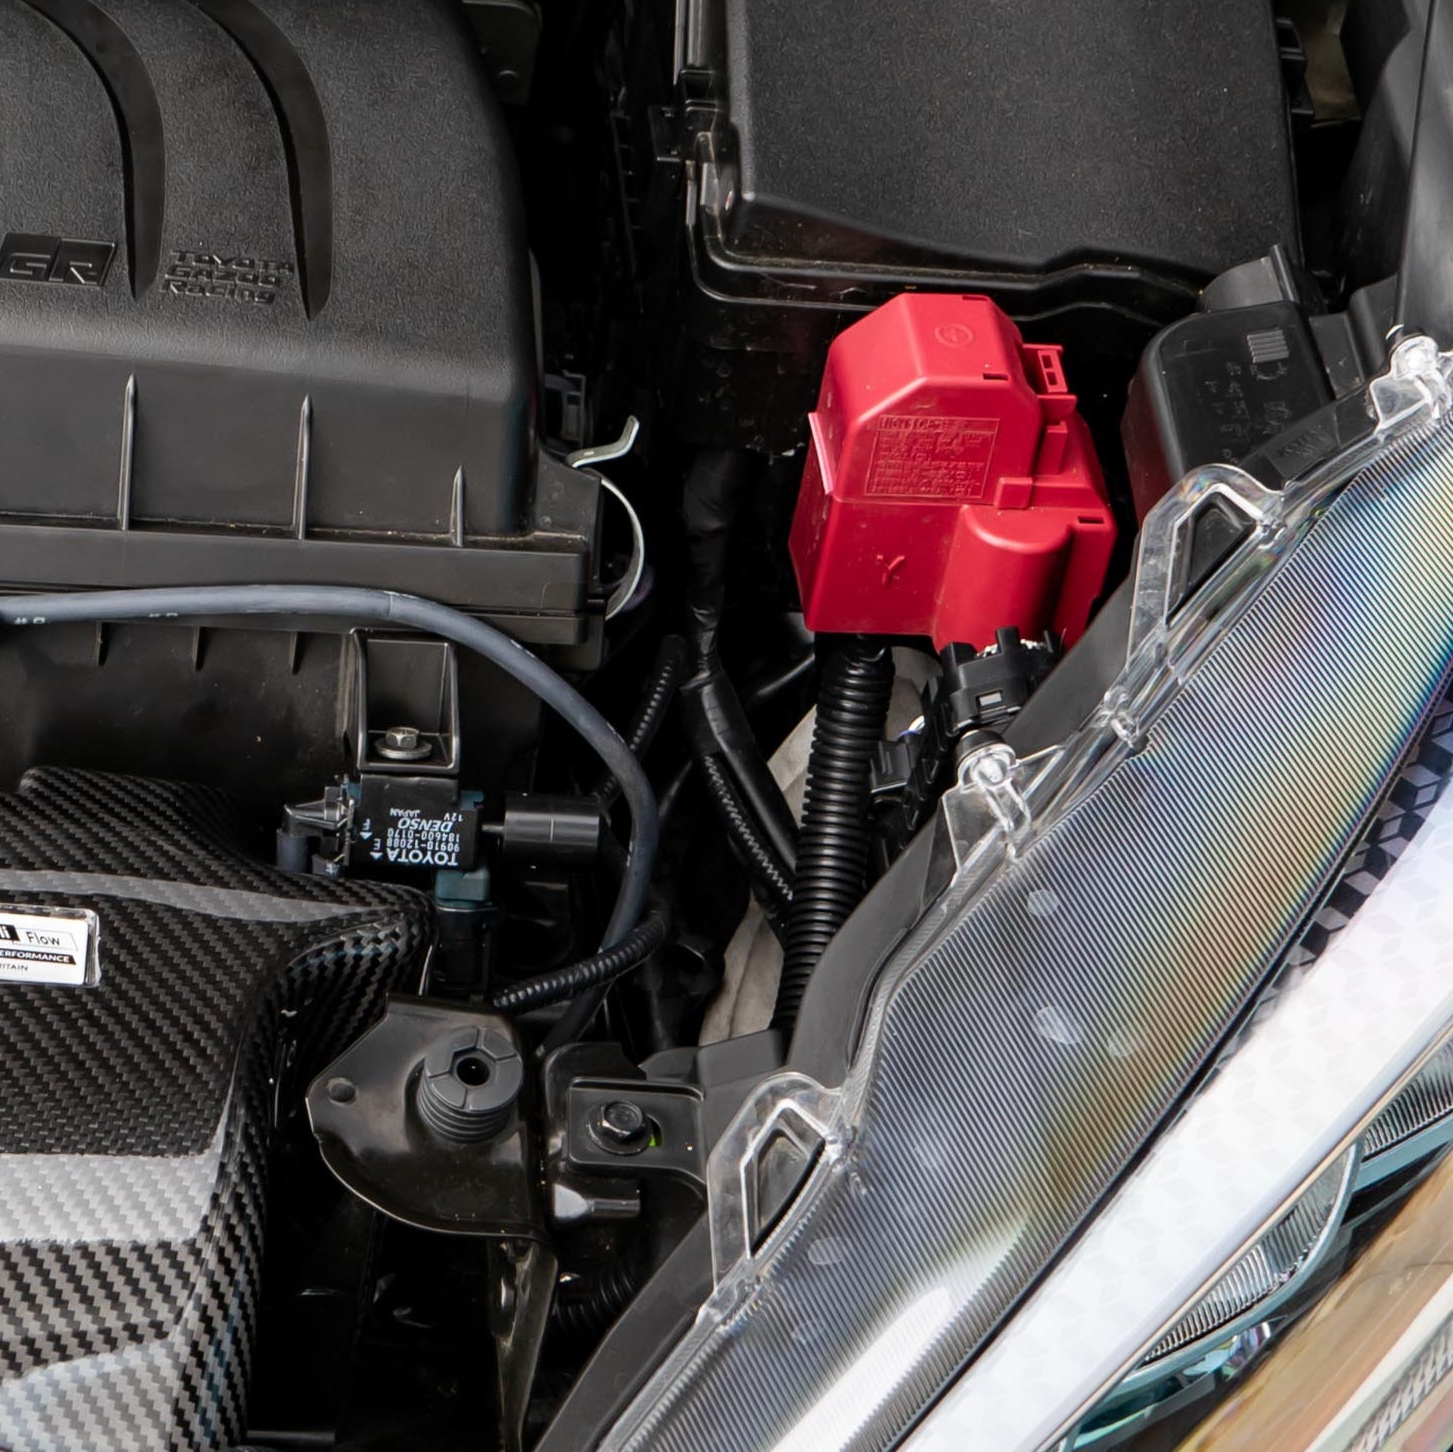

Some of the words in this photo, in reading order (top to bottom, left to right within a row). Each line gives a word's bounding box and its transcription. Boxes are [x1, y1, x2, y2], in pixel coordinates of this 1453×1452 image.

[0, 251, 101, 285] GR
[390, 807, 420, 817] JAPAN
[444, 812, 463, 822] 12V
[398, 818, 453, 832] DENSO
[386, 847, 458, 866] TOYOTA
[26, 931, 60, 946] Flow
